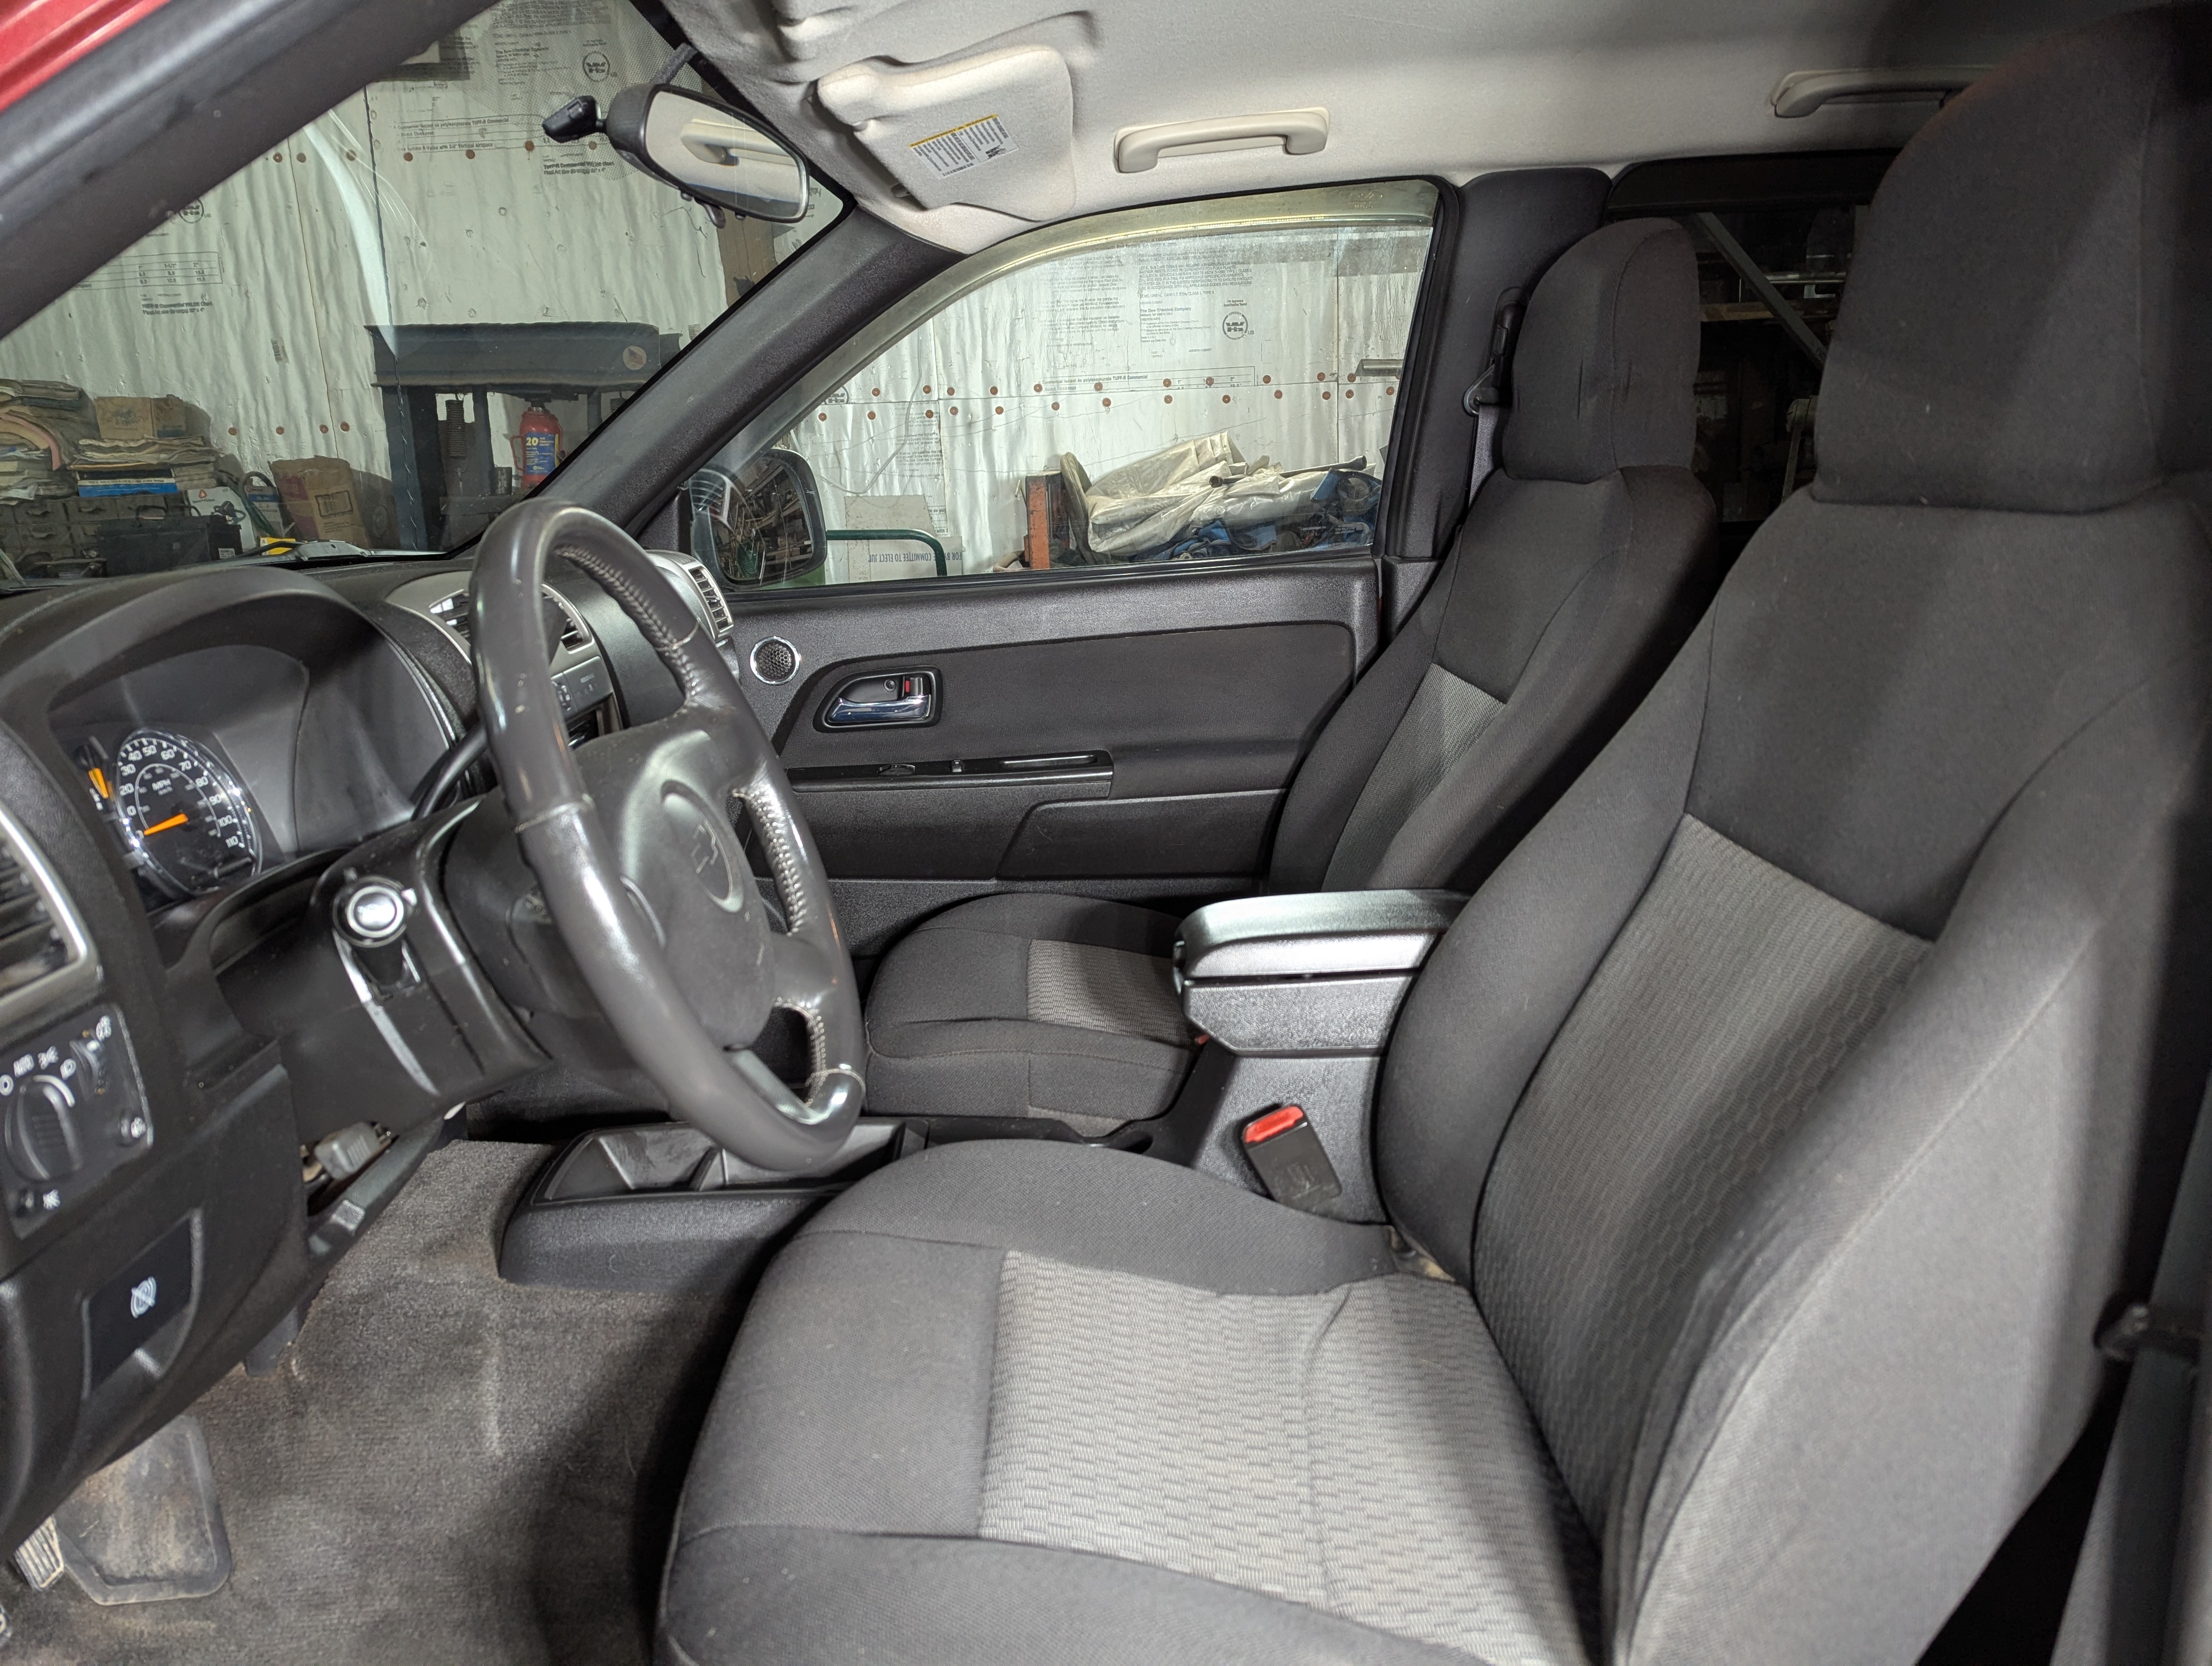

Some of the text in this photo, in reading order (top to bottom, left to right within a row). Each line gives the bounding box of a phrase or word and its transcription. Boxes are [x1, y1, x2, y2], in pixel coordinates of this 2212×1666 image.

[526, 437, 538, 446] 20
[879, 553, 893, 562] ELECT
[895, 553, 902, 562] TO
[903, 552, 931, 562] COMMITTEE
[953, 552, 962, 561] FOR
[128, 750, 143, 761] 40
[142, 745, 157, 757] 50
[160, 749, 175, 760] 60
[120, 764, 136, 776] 30
[178, 760, 191, 771] 70
[195, 776, 208, 787] 80
[119, 783, 134, 796] 20
[209, 794, 222, 806] 90
[217, 815, 233, 828] 100
